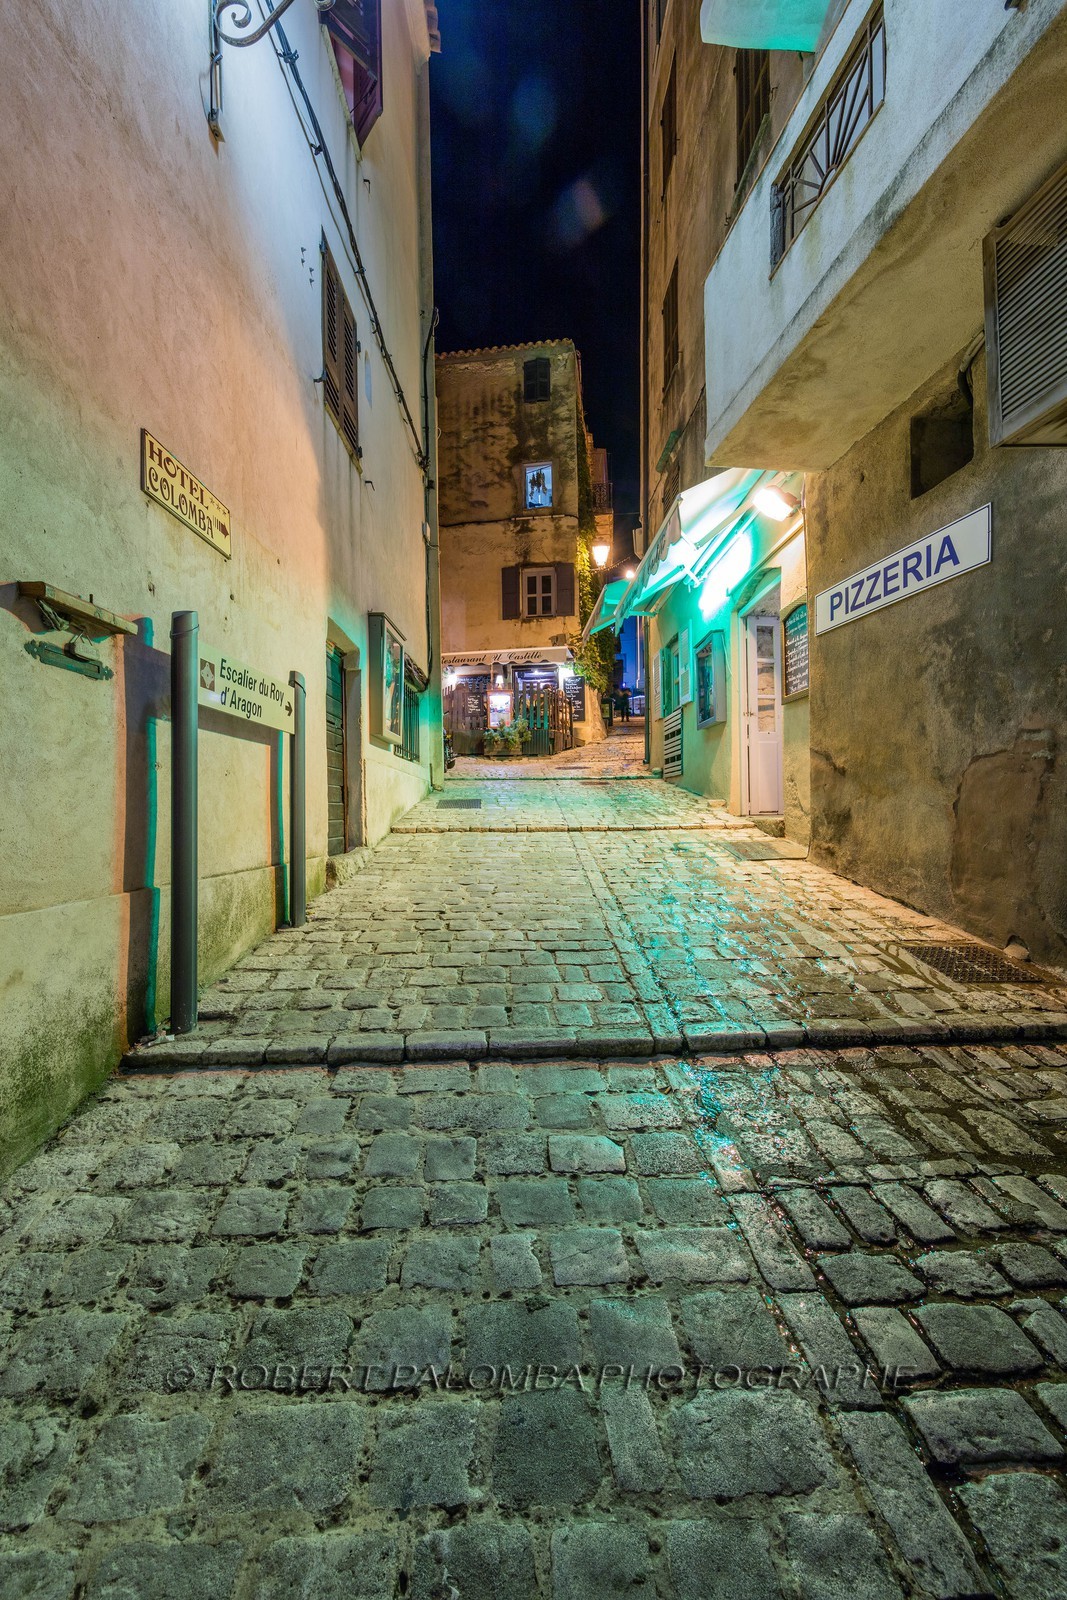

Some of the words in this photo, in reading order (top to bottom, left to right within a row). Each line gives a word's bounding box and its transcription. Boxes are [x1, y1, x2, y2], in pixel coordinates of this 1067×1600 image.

[148, 440, 209, 510] HOTEL
[148, 466, 214, 539] COLOMBA
[829, 534, 961, 622] PIZZERIA
[219, 657, 257, 692] Escalier
[258, 678, 269, 697] du
[270, 683, 285, 707] Roy
